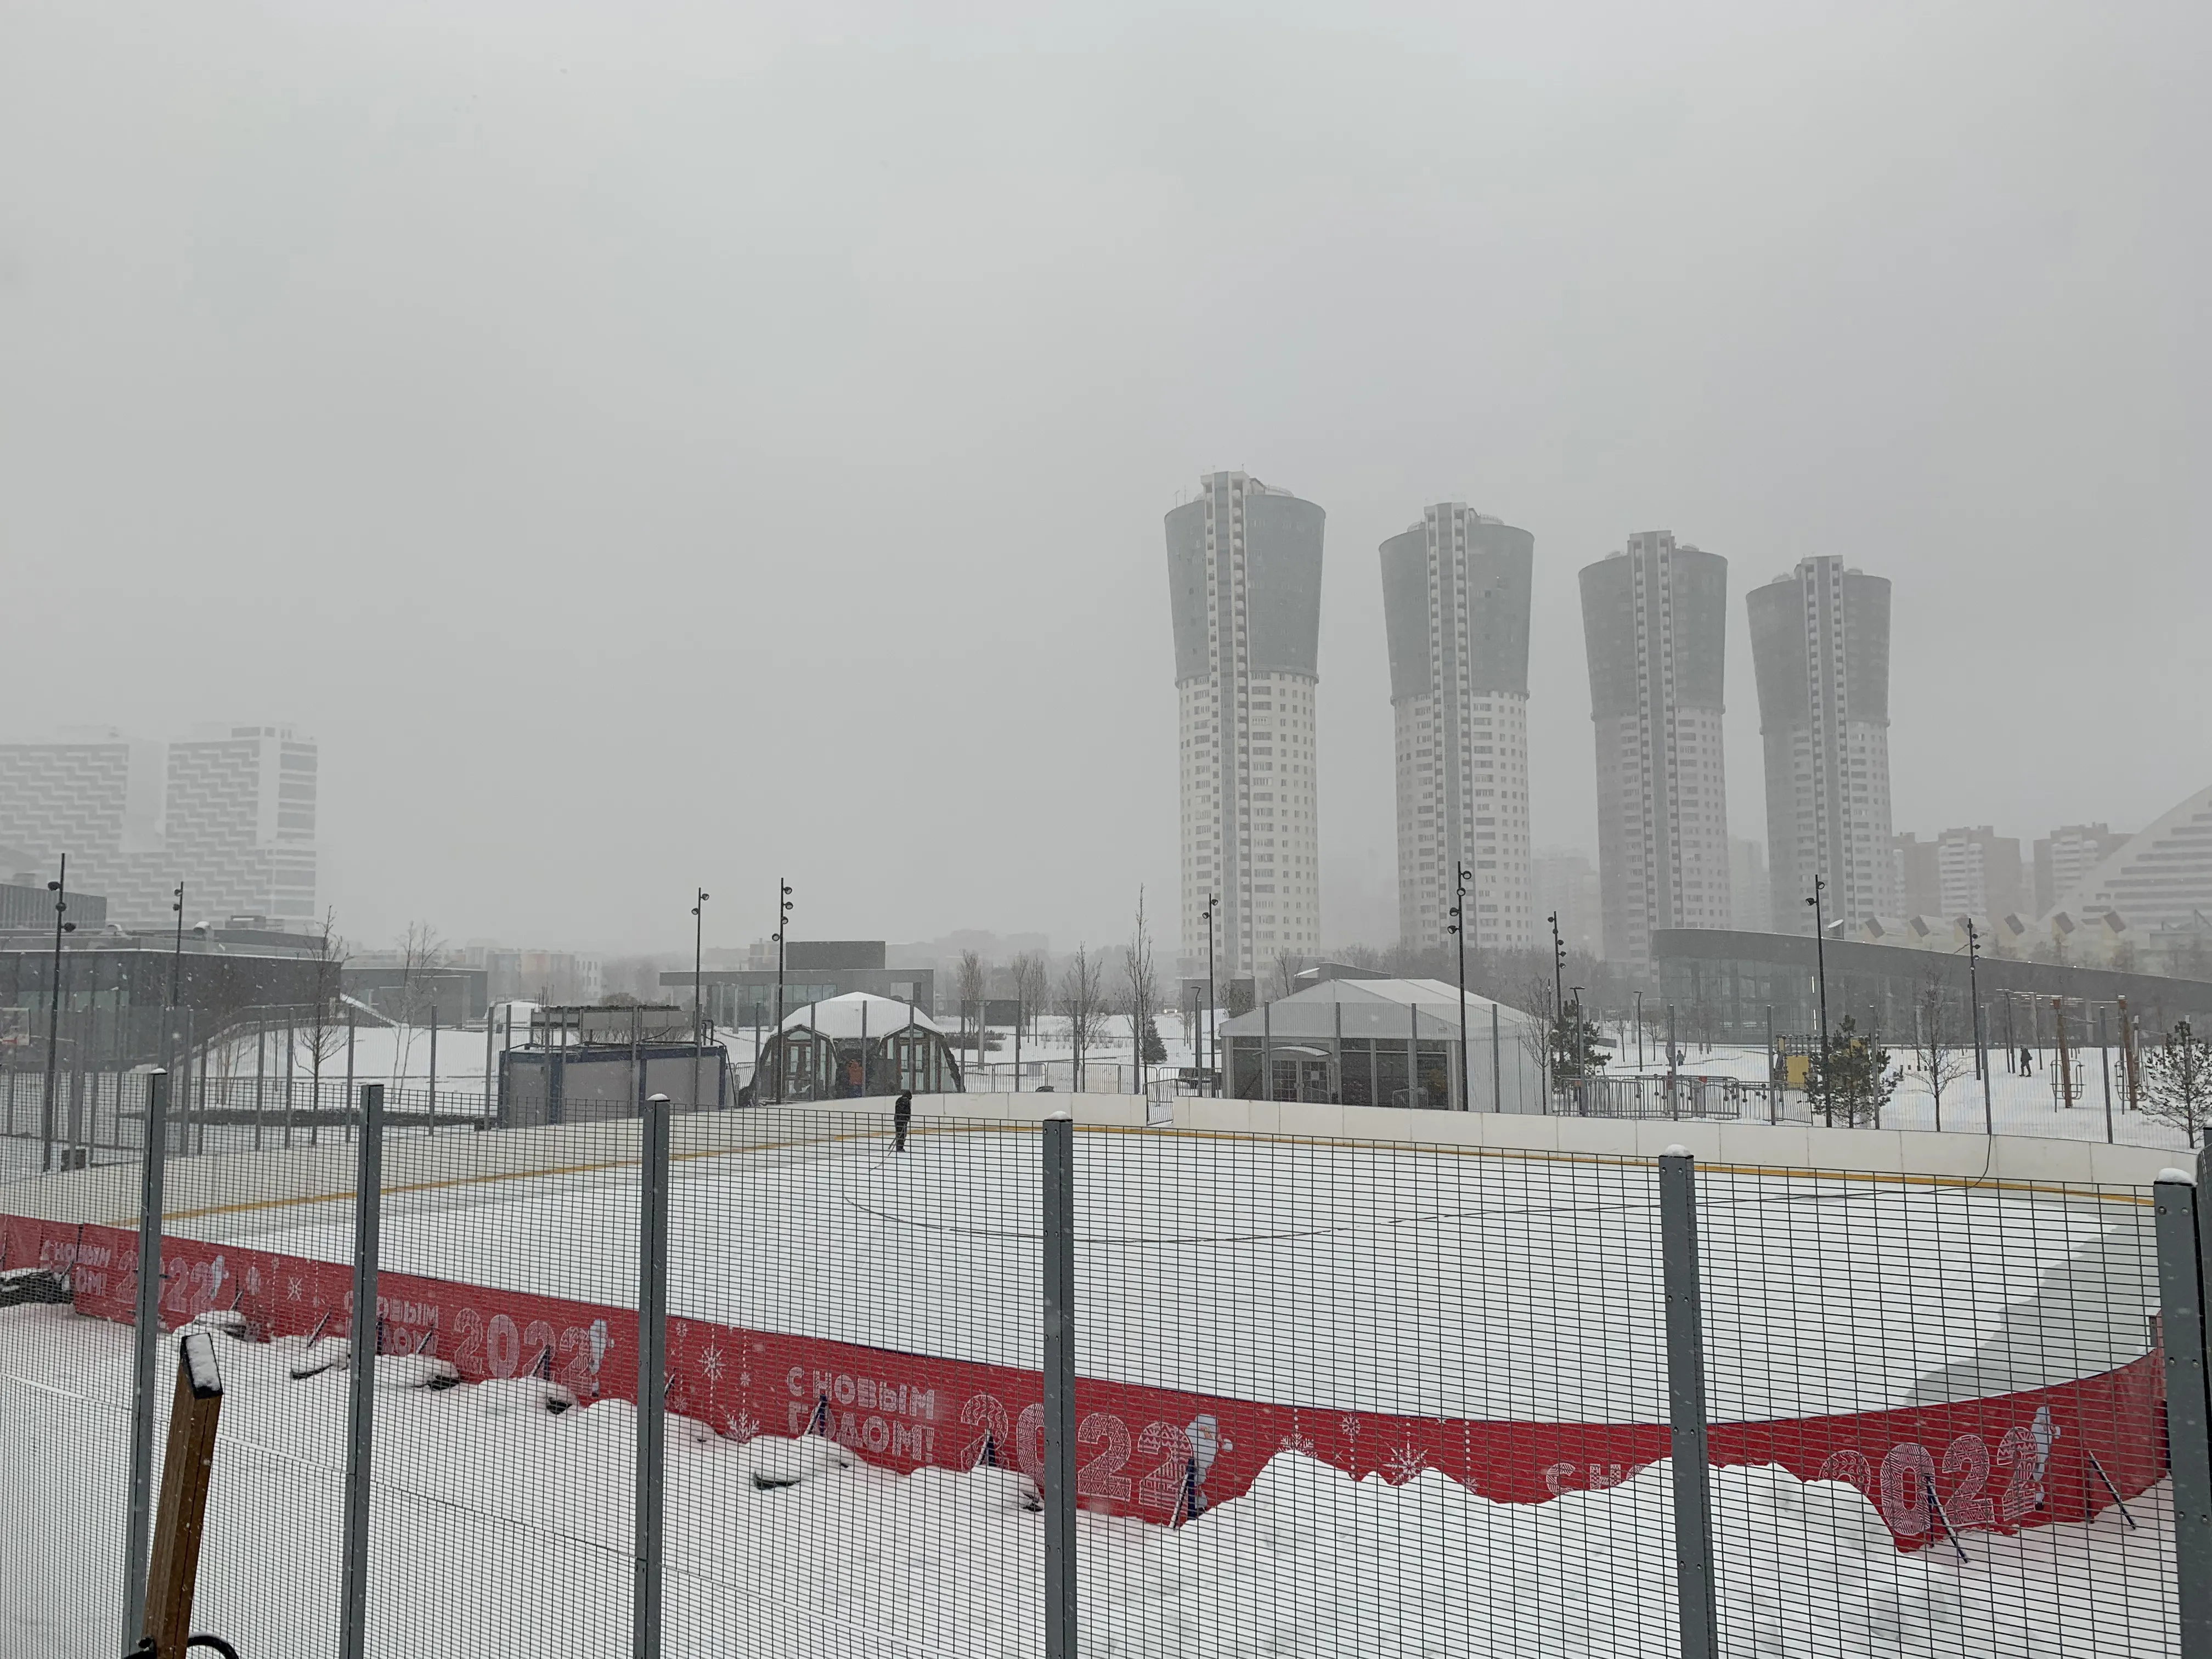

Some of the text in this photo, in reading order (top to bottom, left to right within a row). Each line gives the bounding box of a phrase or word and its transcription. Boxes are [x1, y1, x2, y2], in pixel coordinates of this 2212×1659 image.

[116, 1250, 213, 1316] 222
[376, 1296, 439, 1328] ОВЫМ
[454, 1307, 592, 1397] 2022
[787, 1367, 934, 1420] С НОВЫМ
